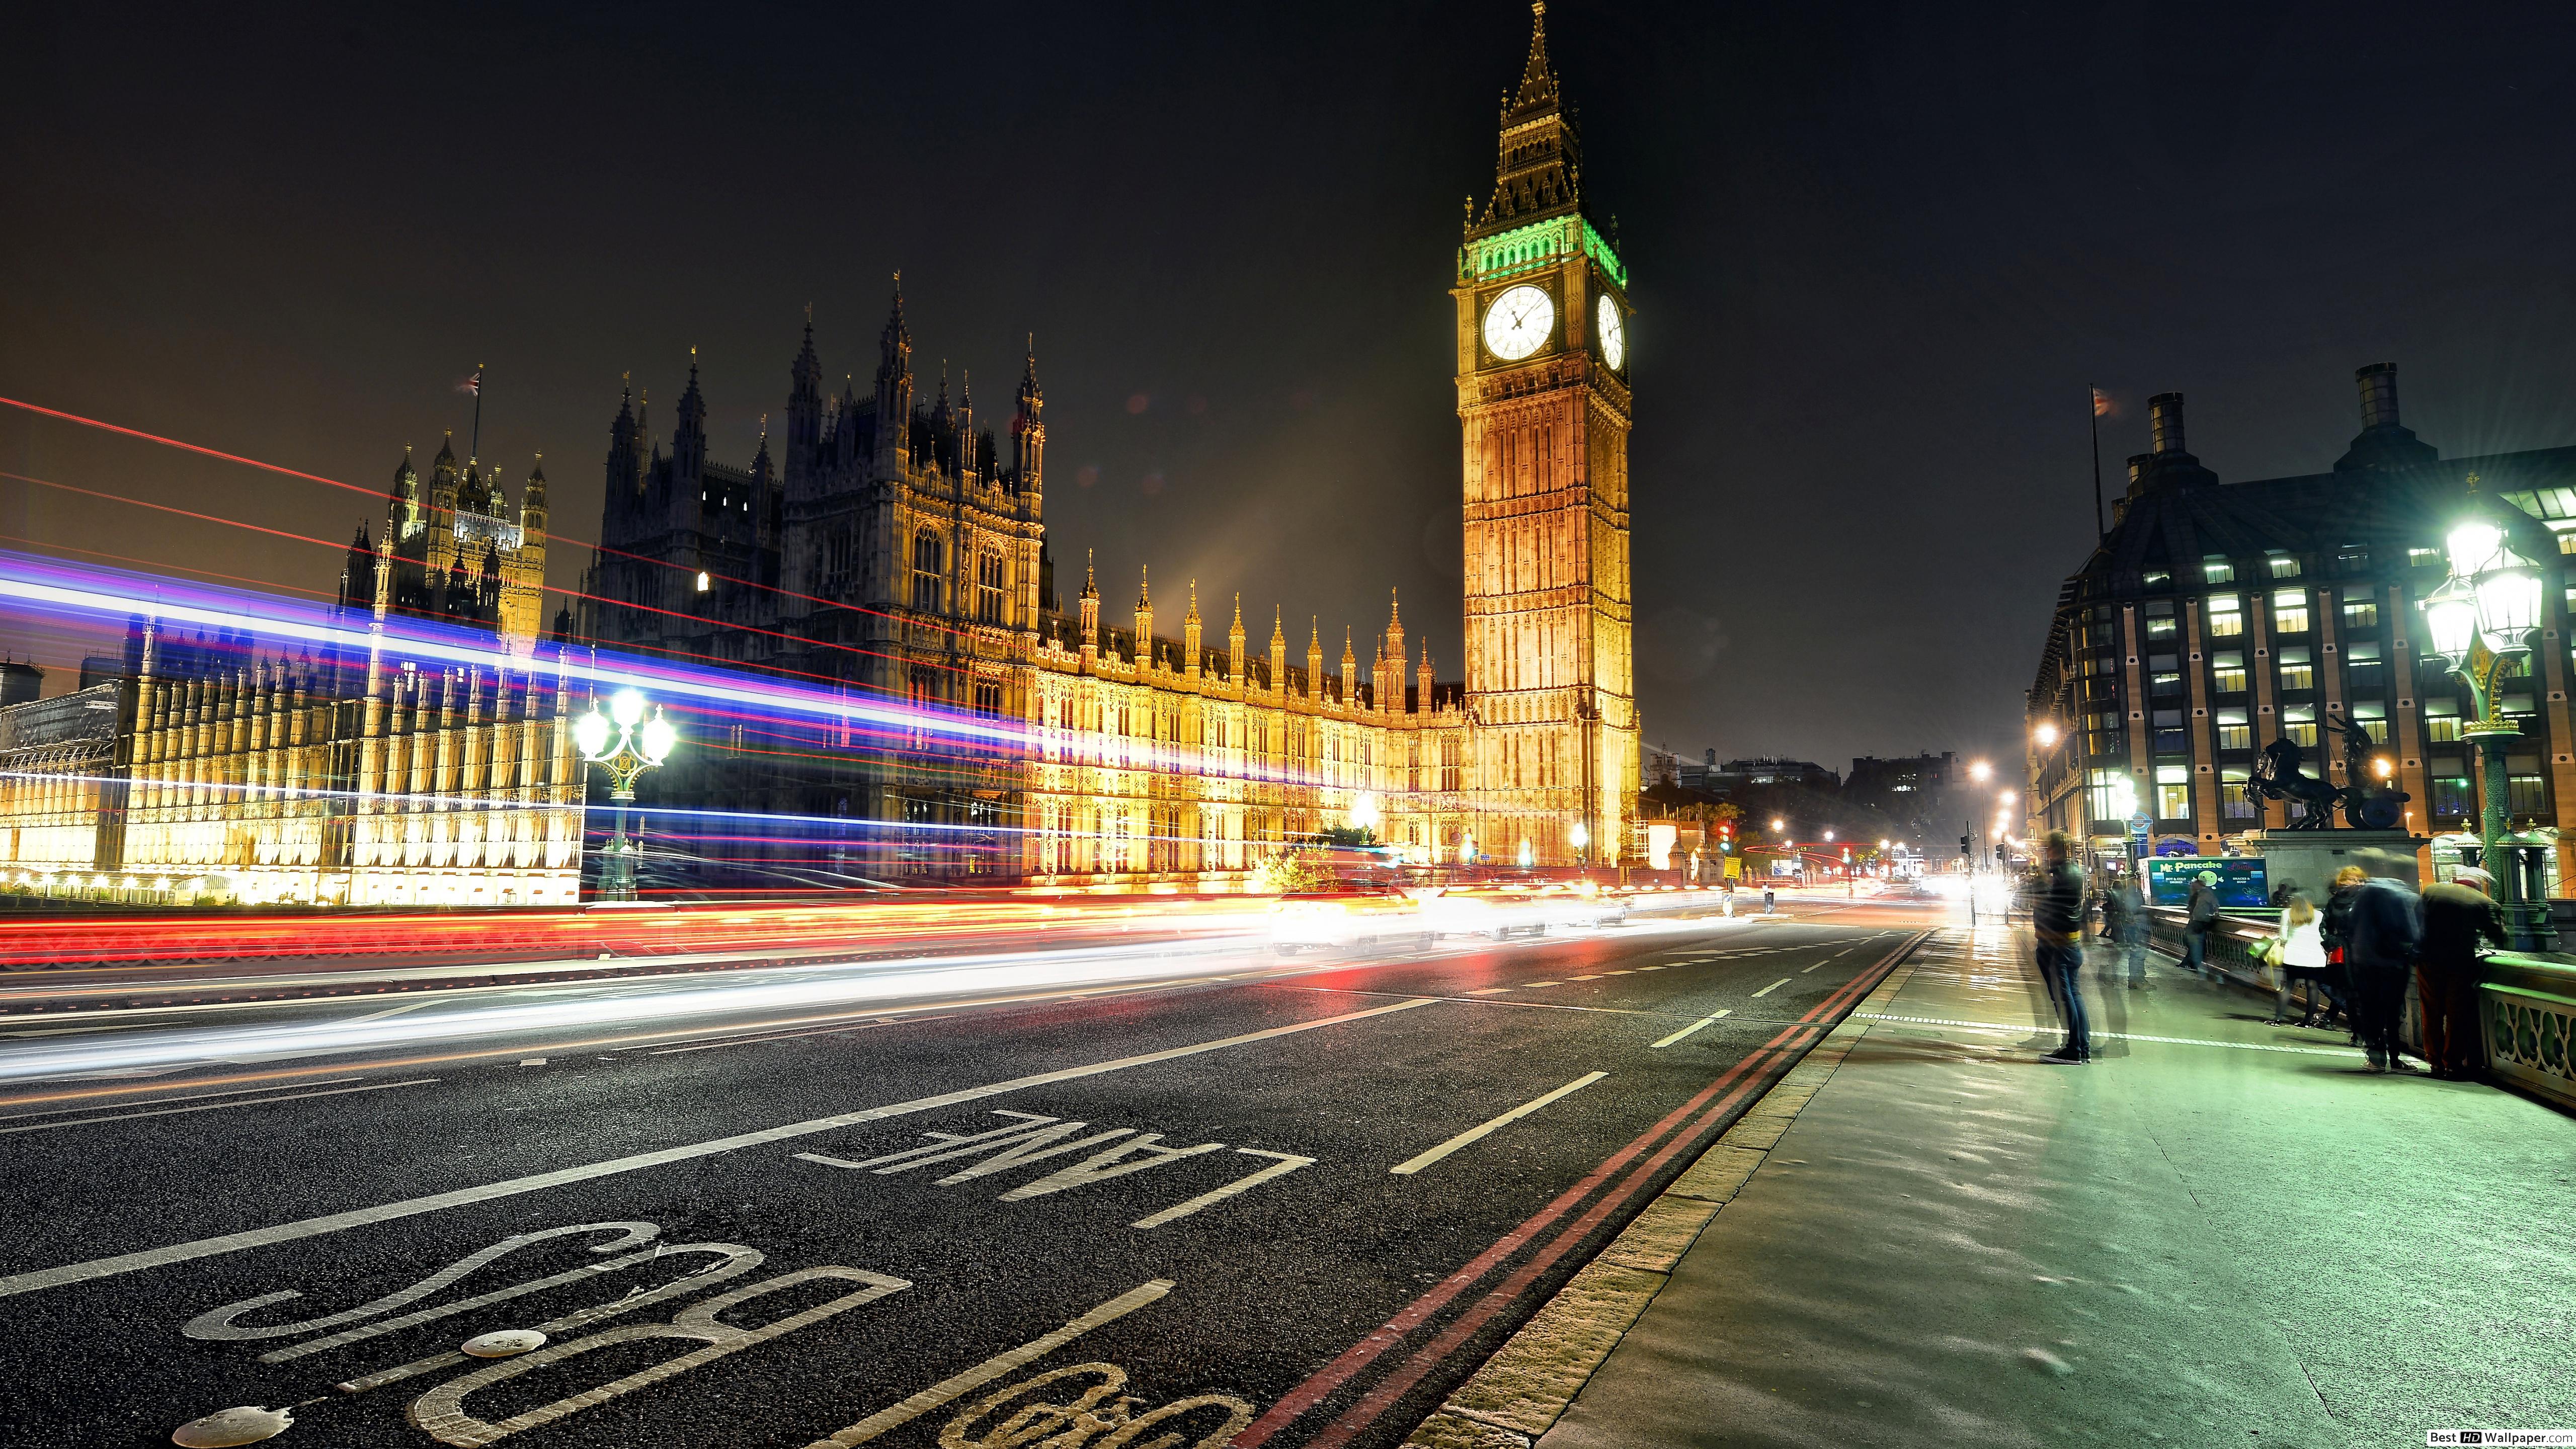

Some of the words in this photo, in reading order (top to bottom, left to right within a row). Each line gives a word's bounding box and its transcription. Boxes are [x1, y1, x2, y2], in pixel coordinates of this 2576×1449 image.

[2160, 863, 2174, 872] Mr.
[2175, 861, 2222, 872] Pancake
[792, 1110, 1316, 1229] LANE
[182, 1221, 913, 1448] BUS
